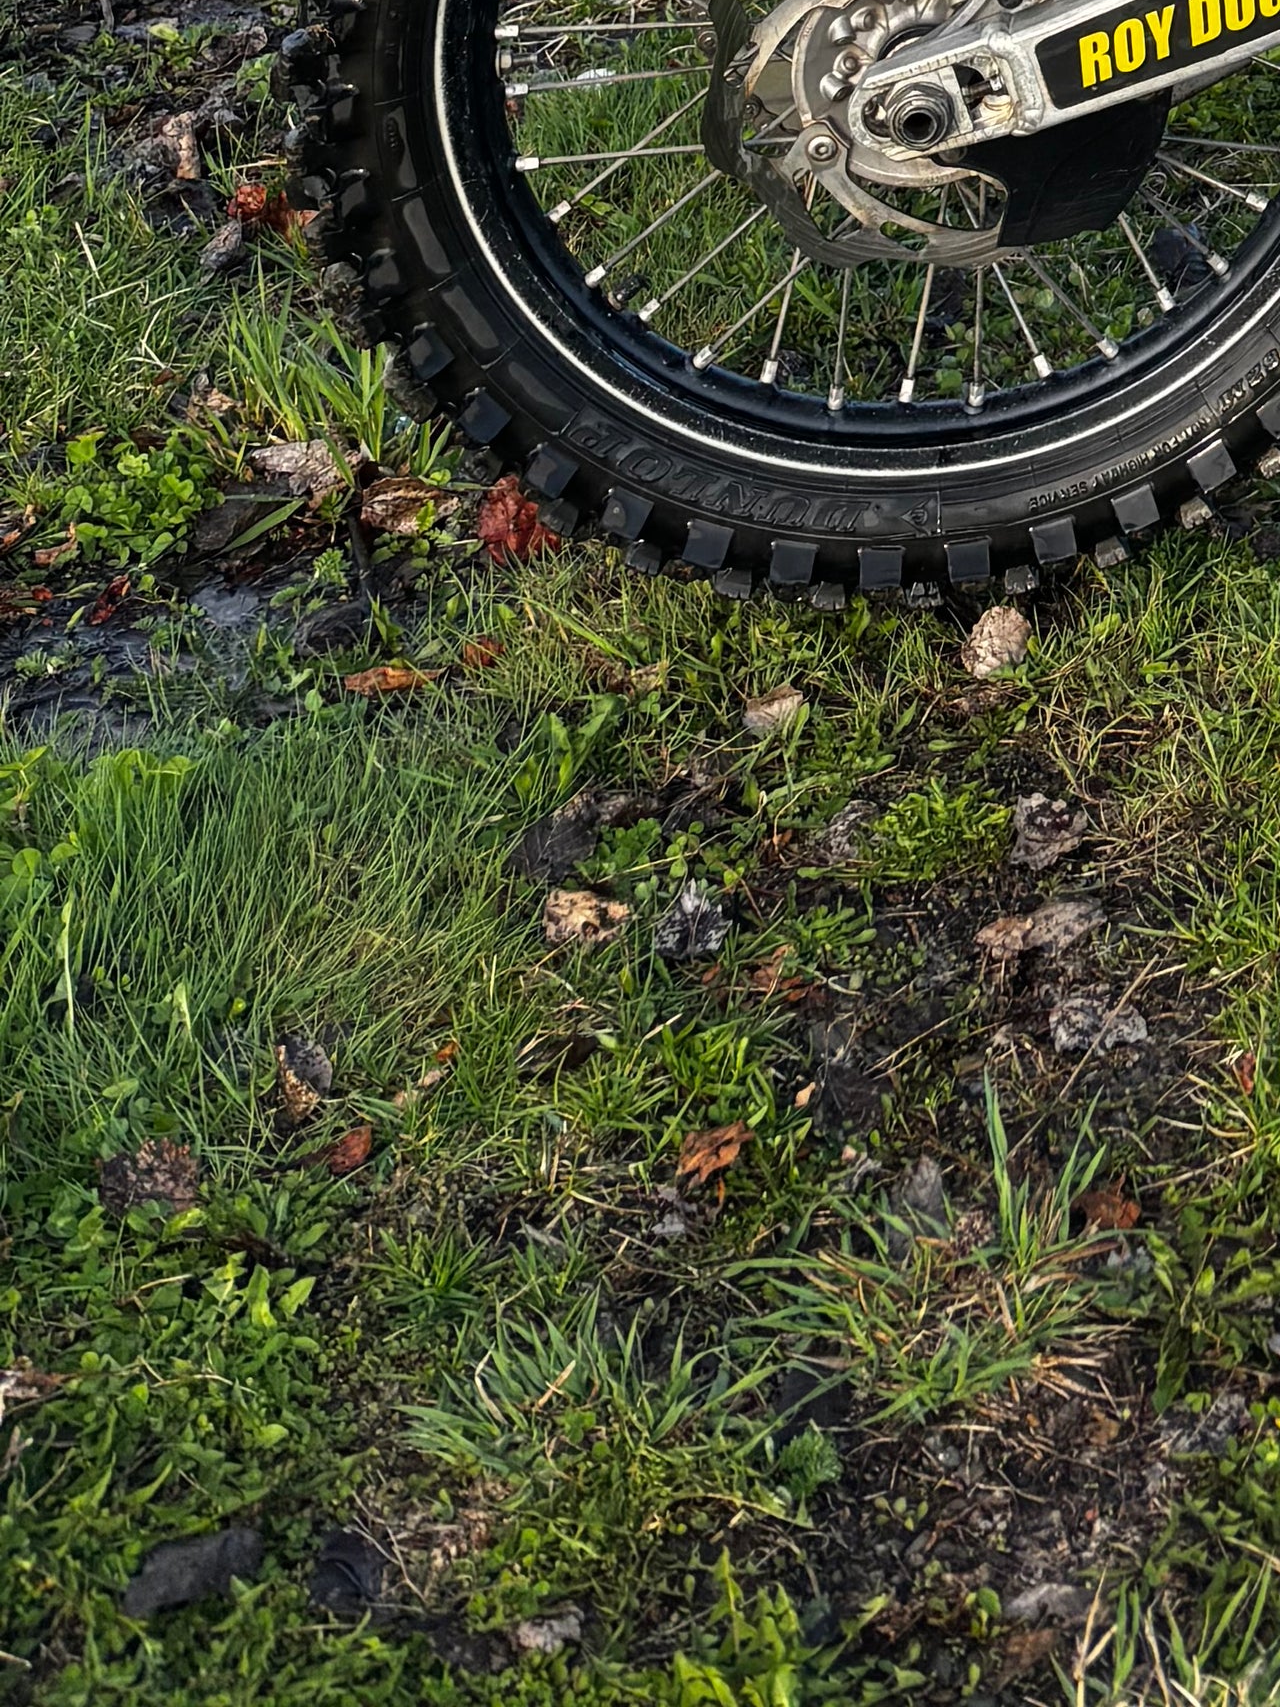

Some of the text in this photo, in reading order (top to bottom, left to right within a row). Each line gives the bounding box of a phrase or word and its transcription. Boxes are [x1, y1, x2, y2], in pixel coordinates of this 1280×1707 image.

[1079, 4, 1175, 88] ROY
[564, 413, 872, 534] DUNLOP
[1028, 476, 1090, 512] SERVICE
